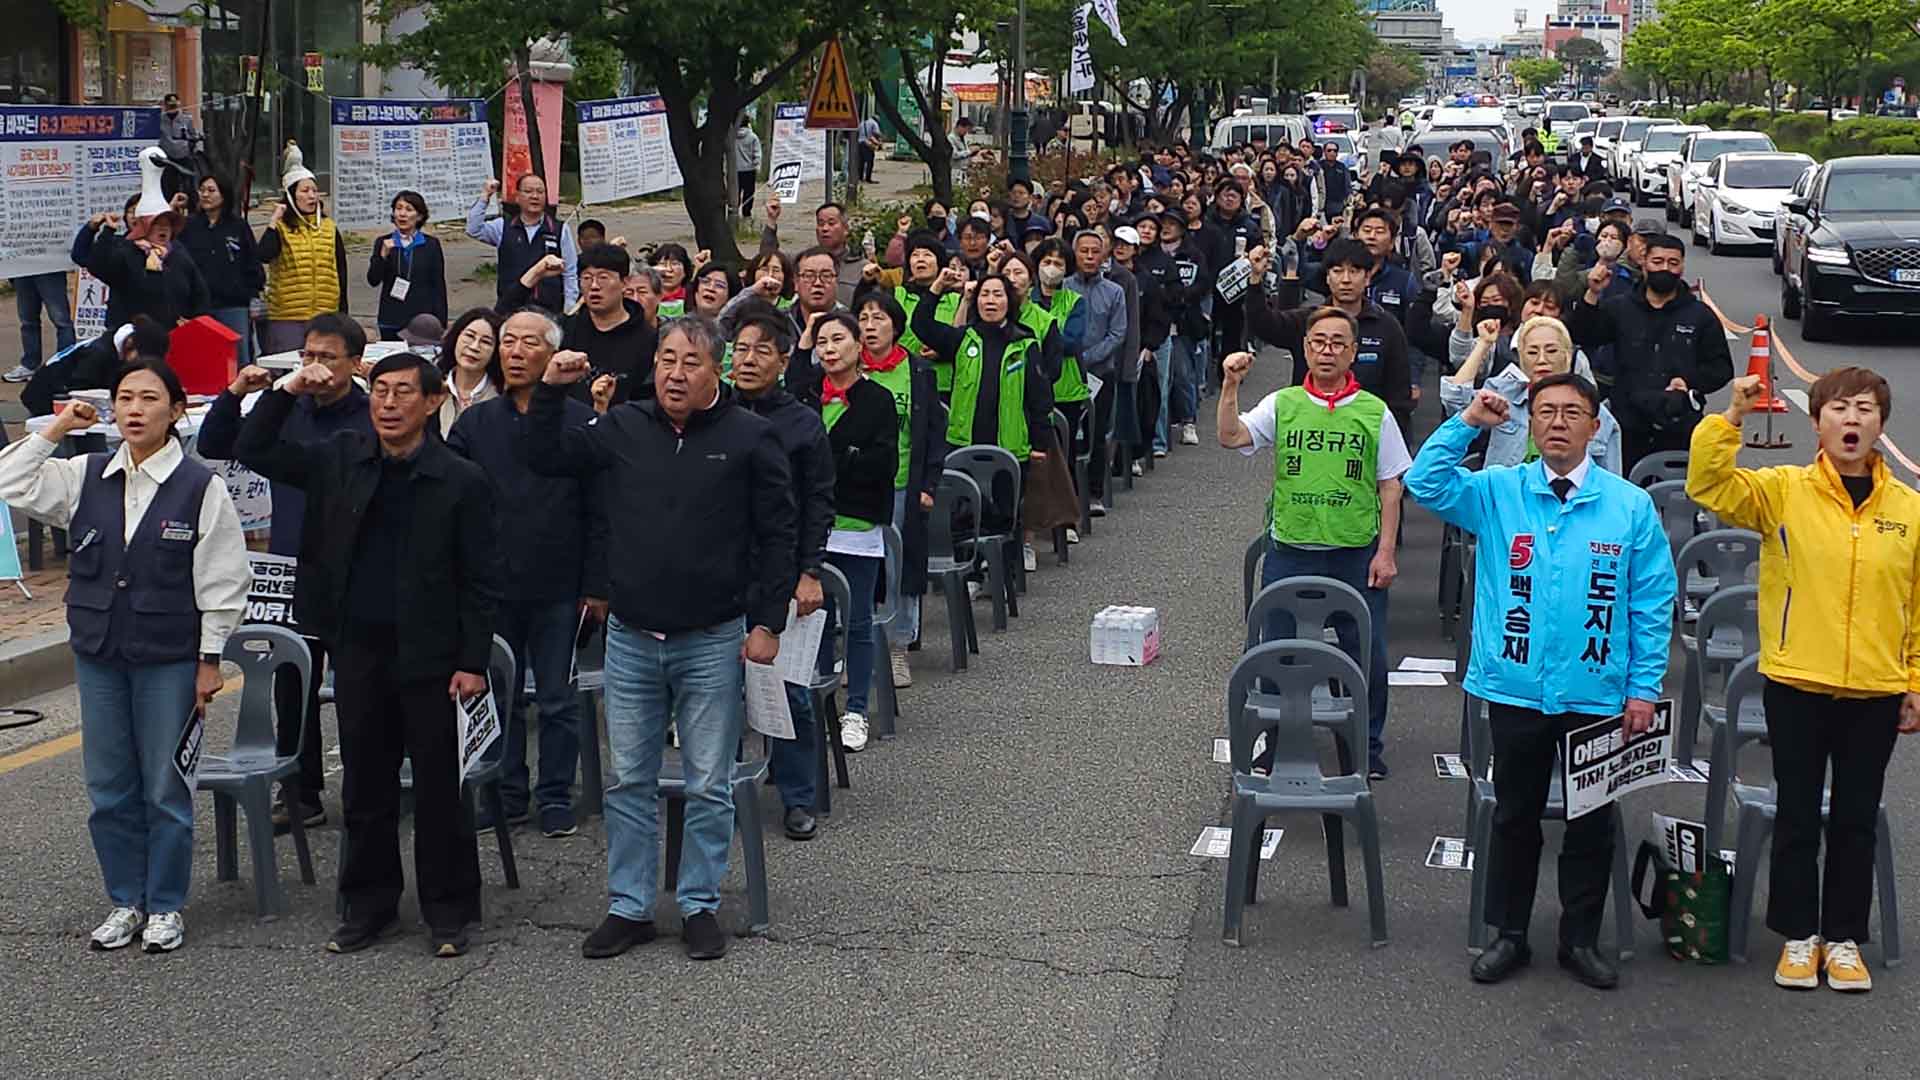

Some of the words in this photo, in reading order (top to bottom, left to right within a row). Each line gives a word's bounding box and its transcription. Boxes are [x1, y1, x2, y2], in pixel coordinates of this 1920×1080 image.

[1287, 430, 1365, 455] 비정규직
[1509, 533, 1535, 570] 5
[1589, 541, 1622, 556] 진보당
[1501, 574, 1532, 665] 백승재
[1580, 571, 1617, 665] 도지사
[1573, 764, 1605, 792] 가자!
[1607, 739, 1662, 778] 노동자의
[1606, 758, 1666, 797] 새벽으로!
